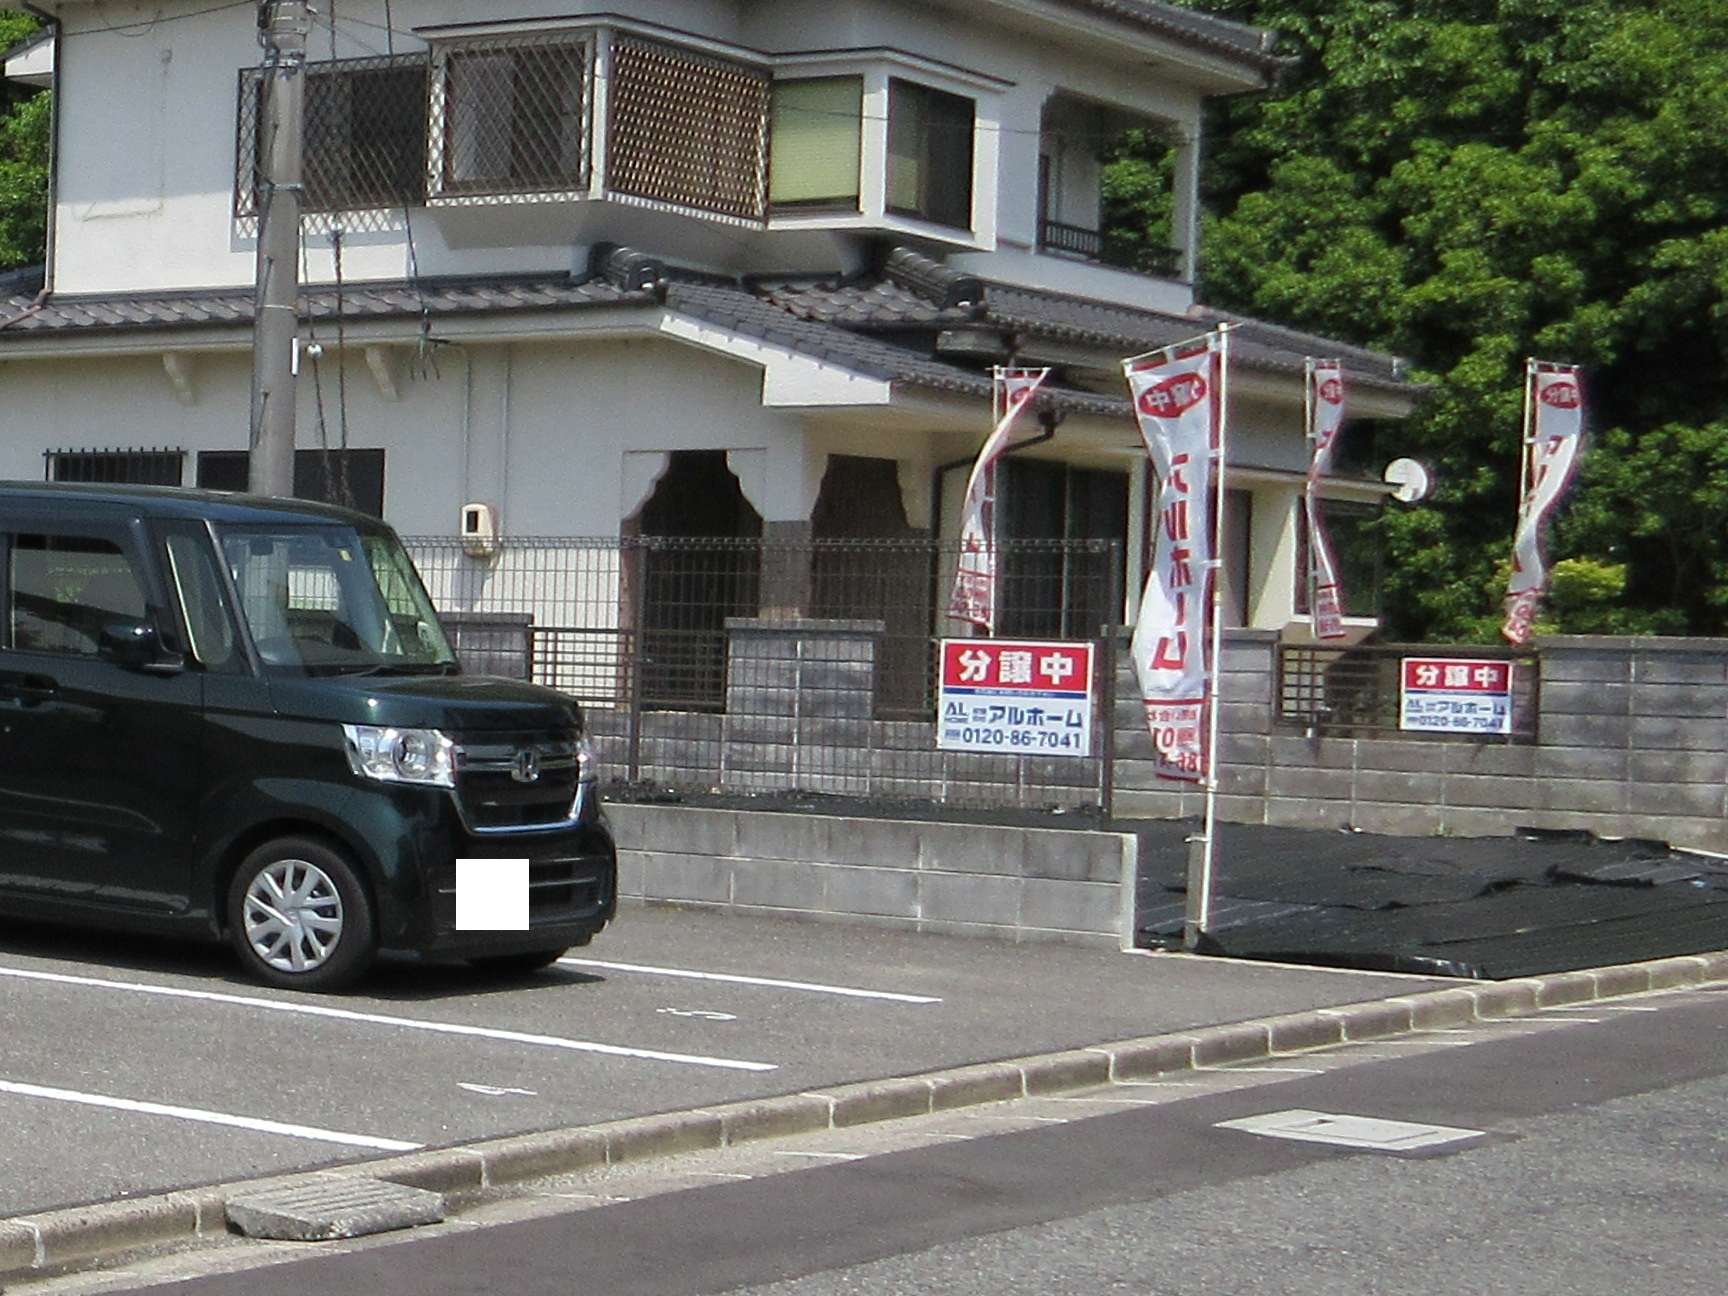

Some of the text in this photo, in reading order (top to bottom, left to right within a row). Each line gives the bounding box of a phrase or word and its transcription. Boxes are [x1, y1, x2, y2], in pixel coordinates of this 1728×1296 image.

[959, 649, 1073, 685] 分譲中
[988, 705, 1082, 728] アルホーム
[962, 727, 1081, 749] 0120-86-7041
